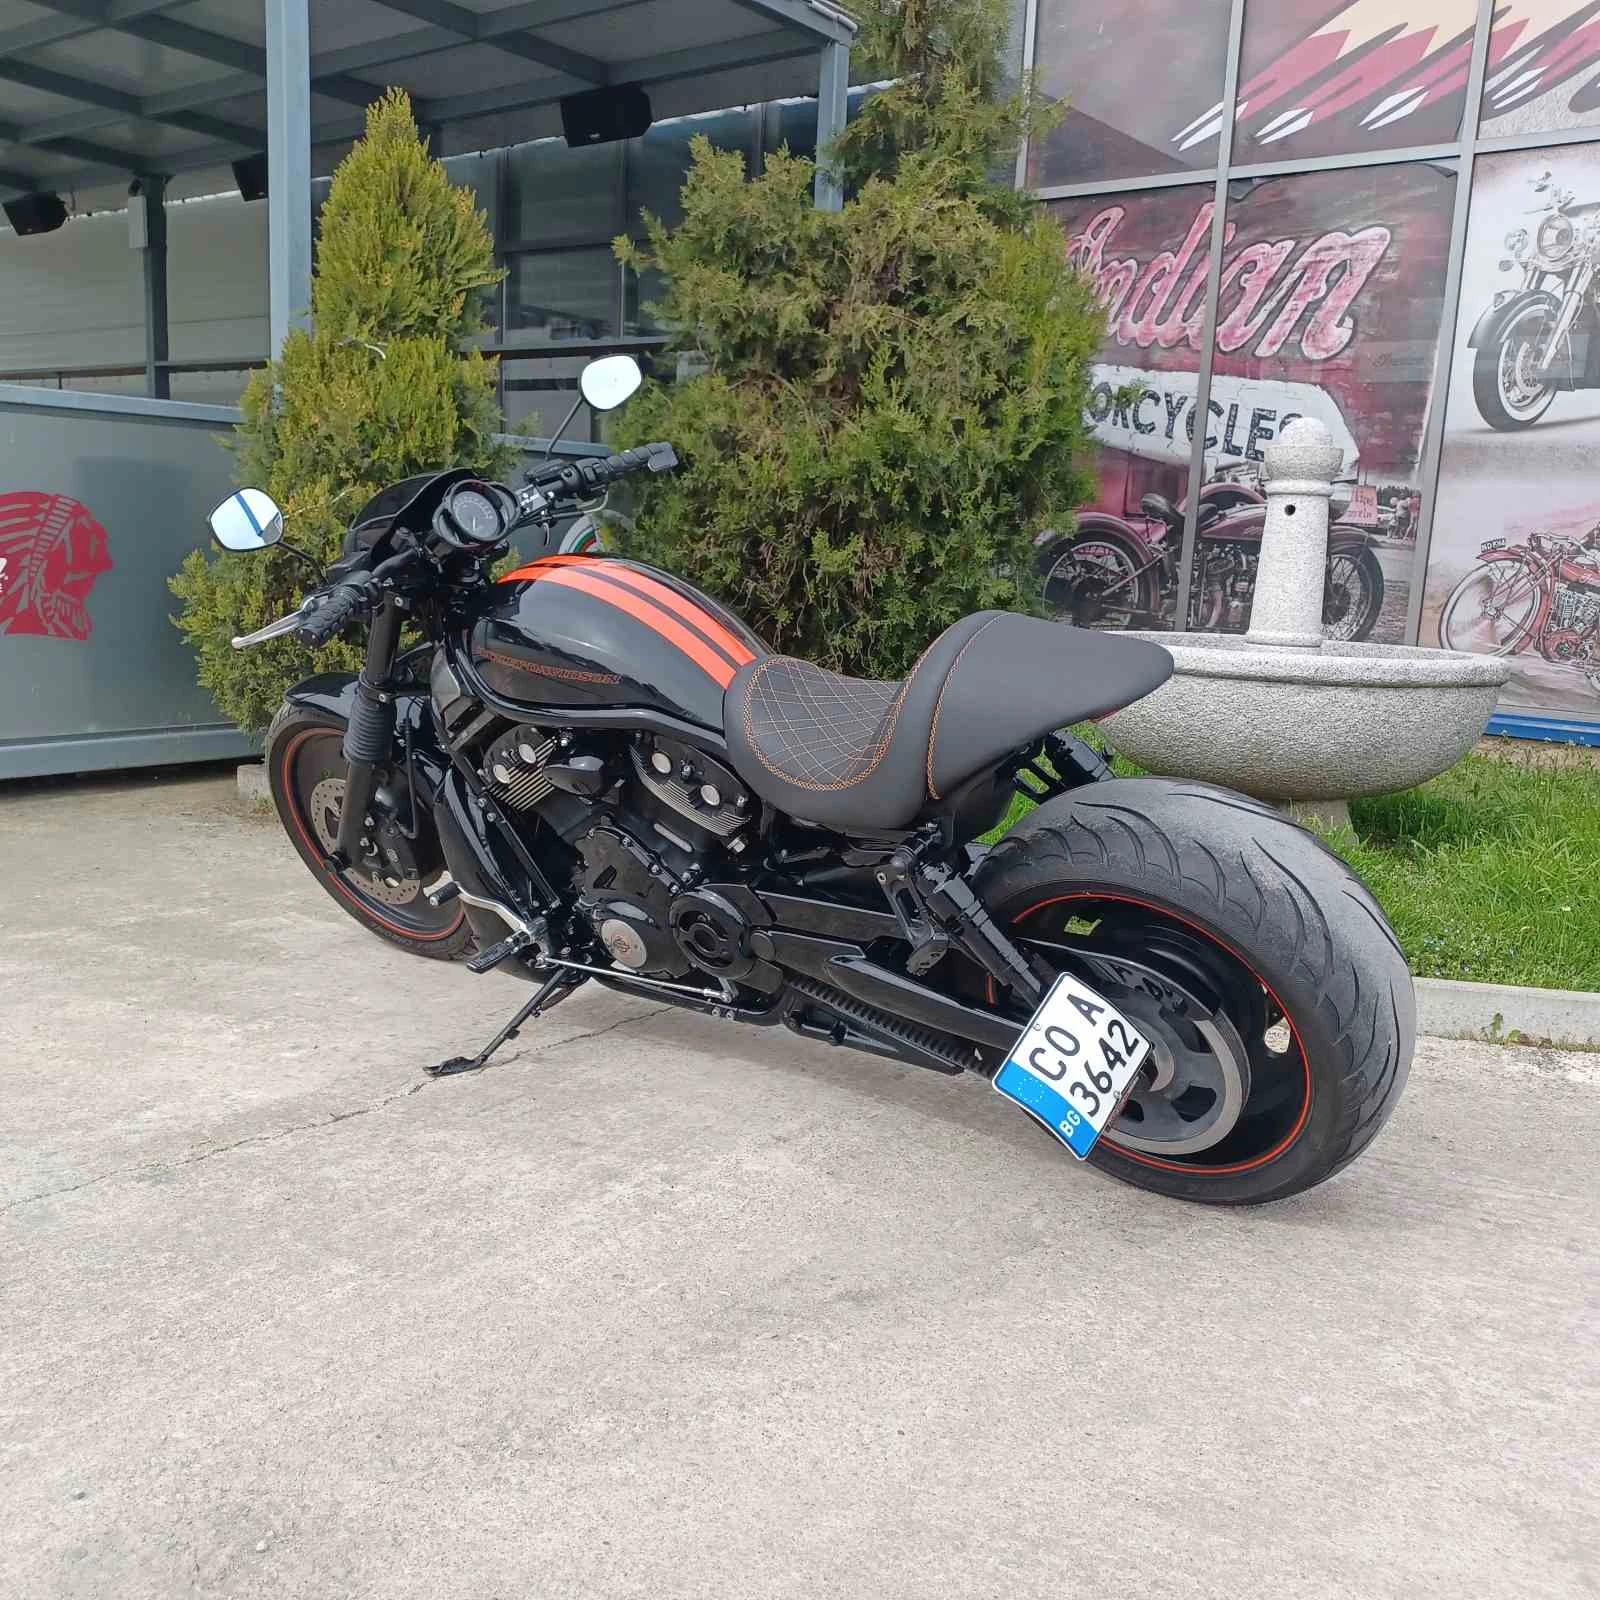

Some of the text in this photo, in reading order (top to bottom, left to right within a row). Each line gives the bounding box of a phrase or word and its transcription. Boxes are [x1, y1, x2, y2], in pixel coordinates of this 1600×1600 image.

[1066, 200, 1392, 360] Indian
[1066, 993, 1105, 1027] A
[1069, 1019, 1140, 1117] 3642
[1059, 1110, 1081, 1138] BG
